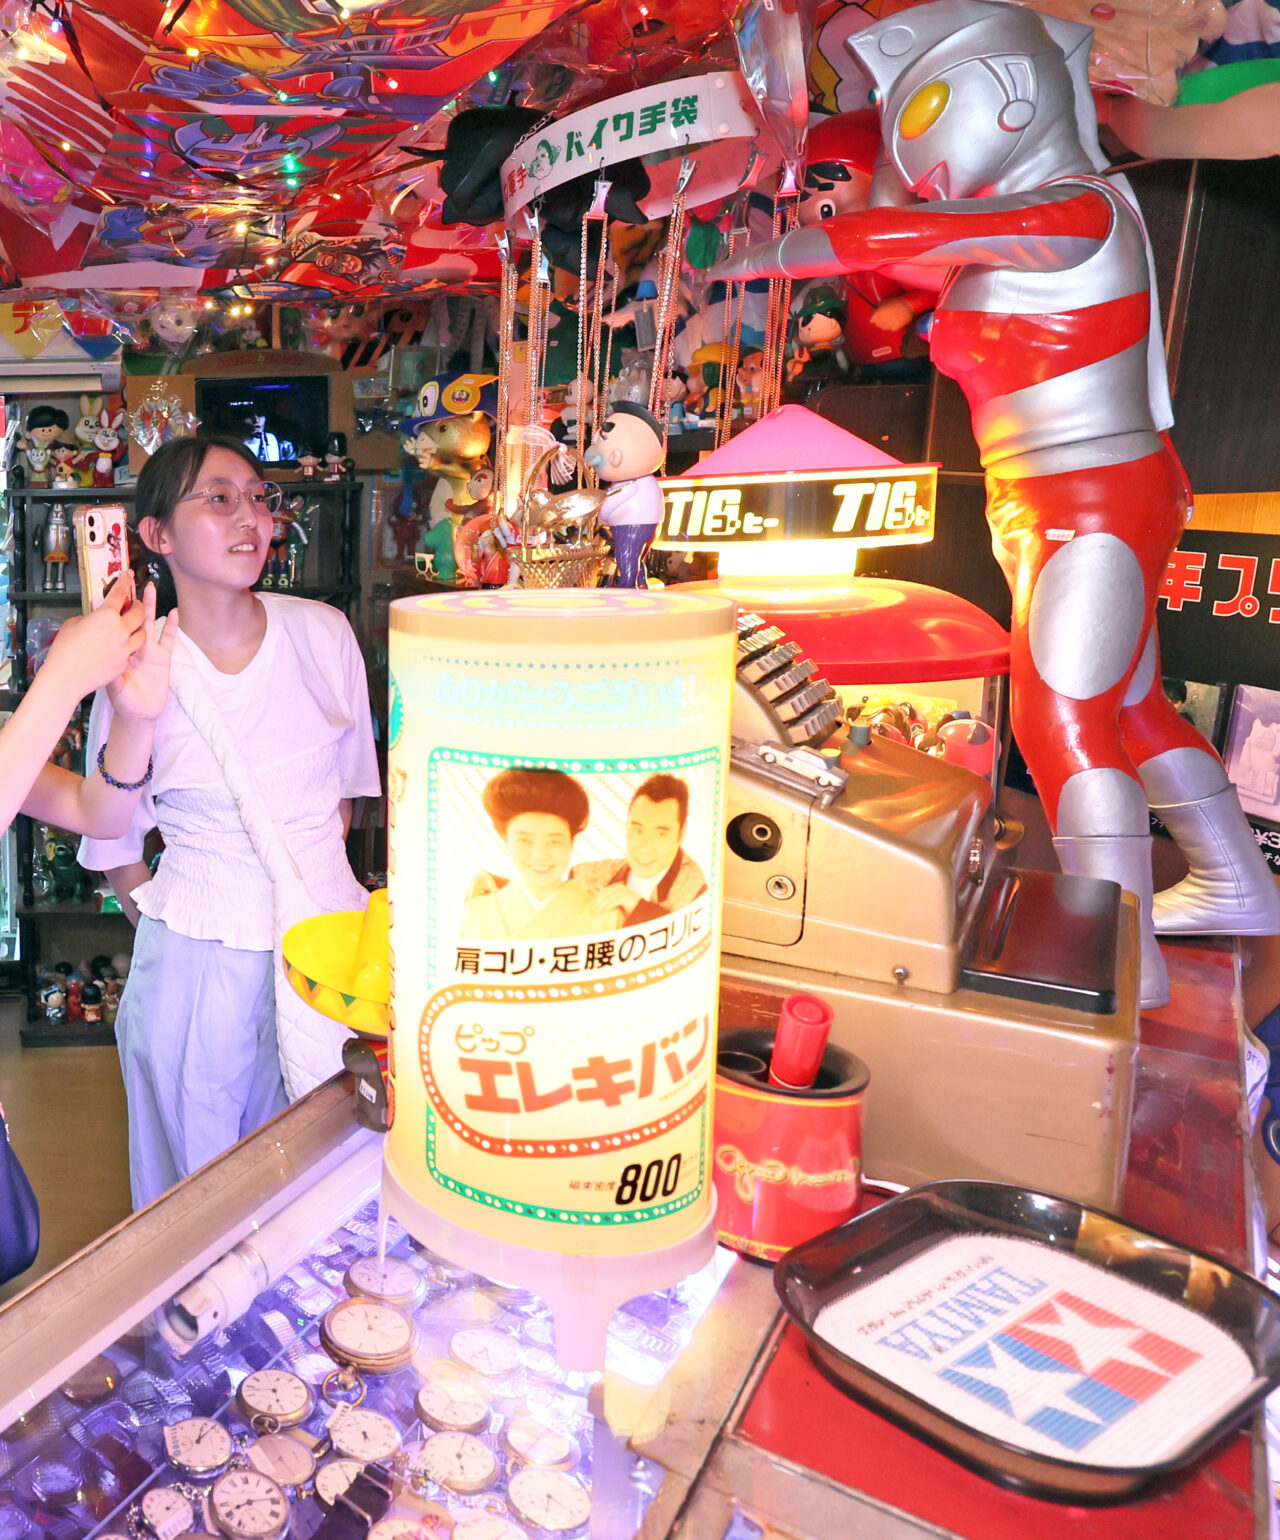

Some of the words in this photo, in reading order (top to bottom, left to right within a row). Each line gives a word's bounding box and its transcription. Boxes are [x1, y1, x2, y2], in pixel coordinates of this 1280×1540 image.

[565, 94, 698, 163] バイク手袋
[454, 918, 702, 975] 肩コリ・足腰のコリに
[454, 1024, 536, 1054] ピップ
[459, 1012, 710, 1114] エレキバン
[615, 1153, 682, 1206] 800
[874, 1264, 1048, 1363] TAMIYA
